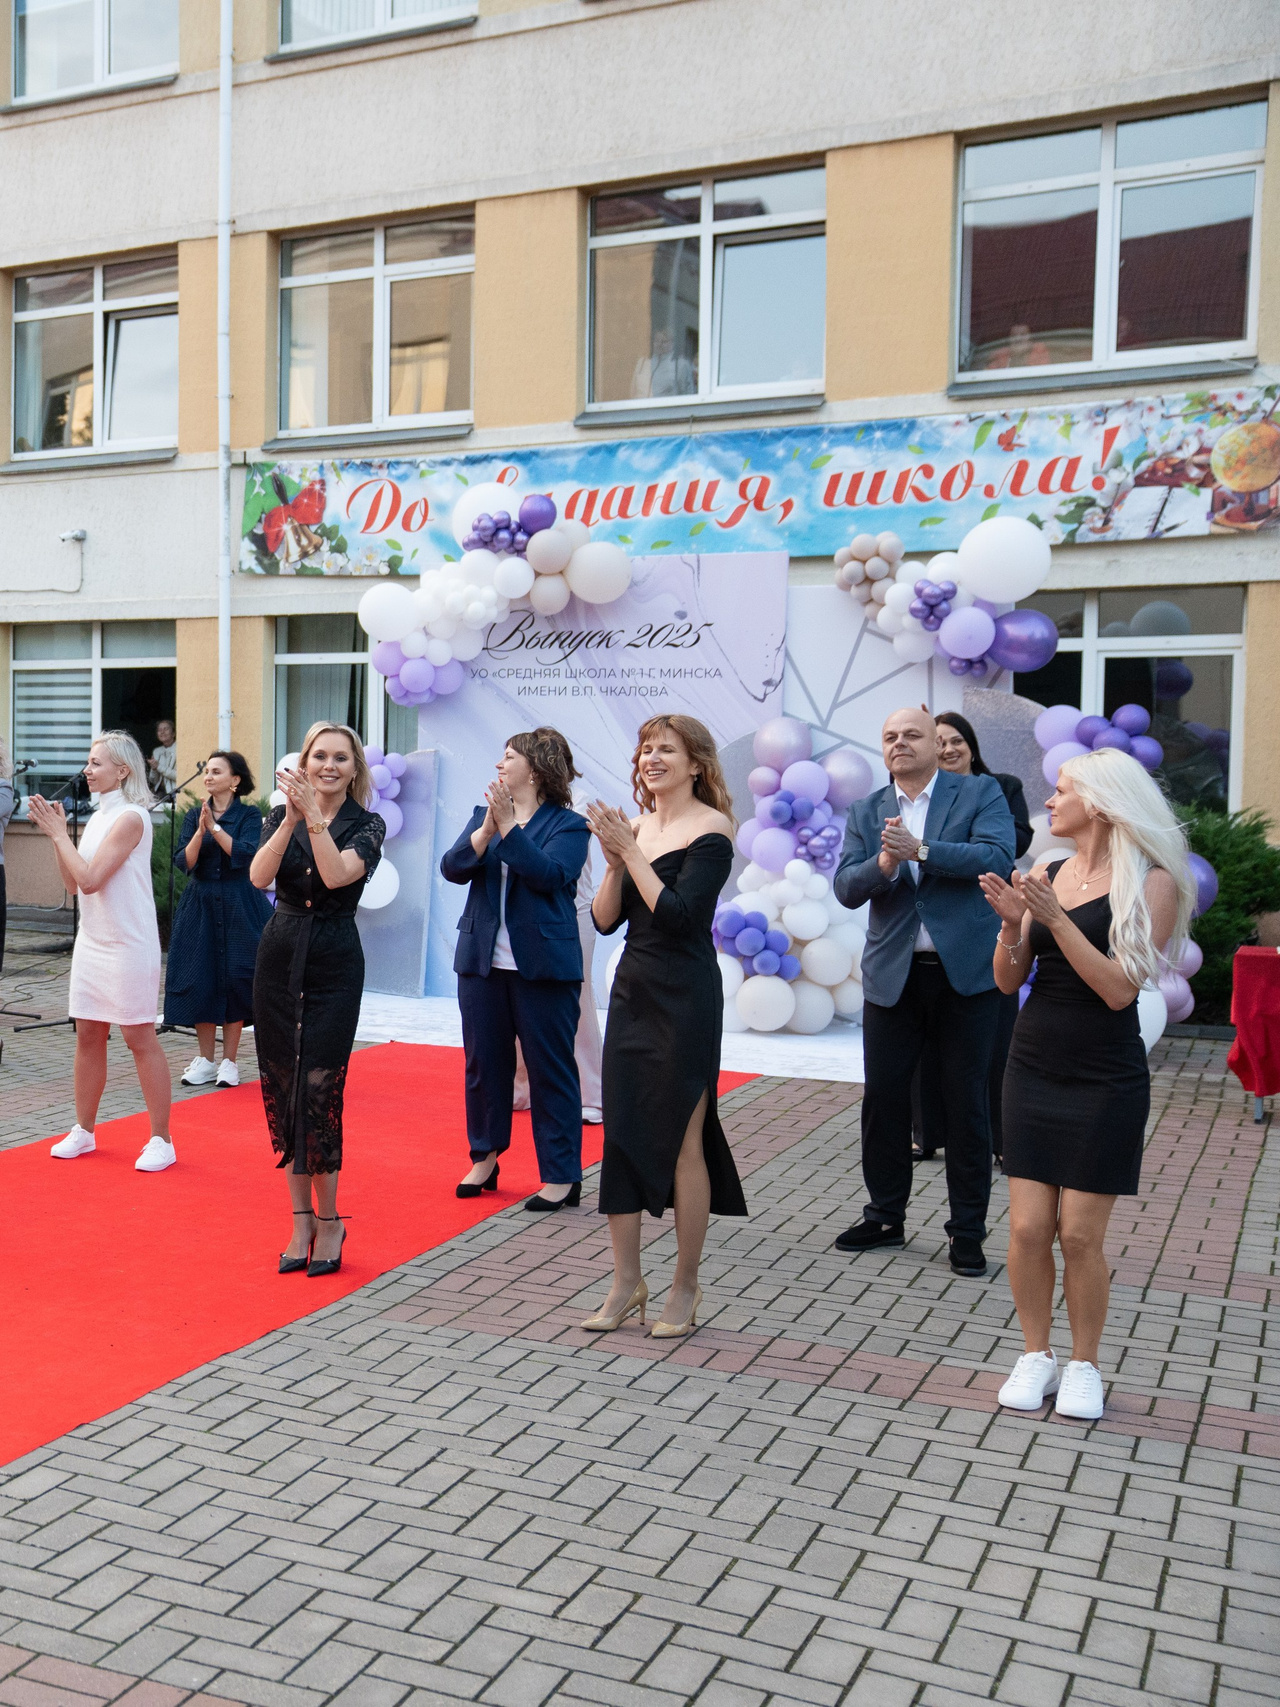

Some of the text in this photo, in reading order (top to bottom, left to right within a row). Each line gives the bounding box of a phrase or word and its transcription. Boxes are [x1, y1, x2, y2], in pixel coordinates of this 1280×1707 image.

[346, 425, 1122, 534] До дания, школа!
[481, 609, 714, 666] Выпуск 2025
[470, 668, 489, 679] УО
[492, 668, 561, 680] «СРЕДНЯЯ
[565, 668, 617, 679] ШКОЛА
[660, 667, 723, 679] МИНСКА
[517, 685, 669, 697] ИМЕНИ В.П. ЧКАЛОВА
